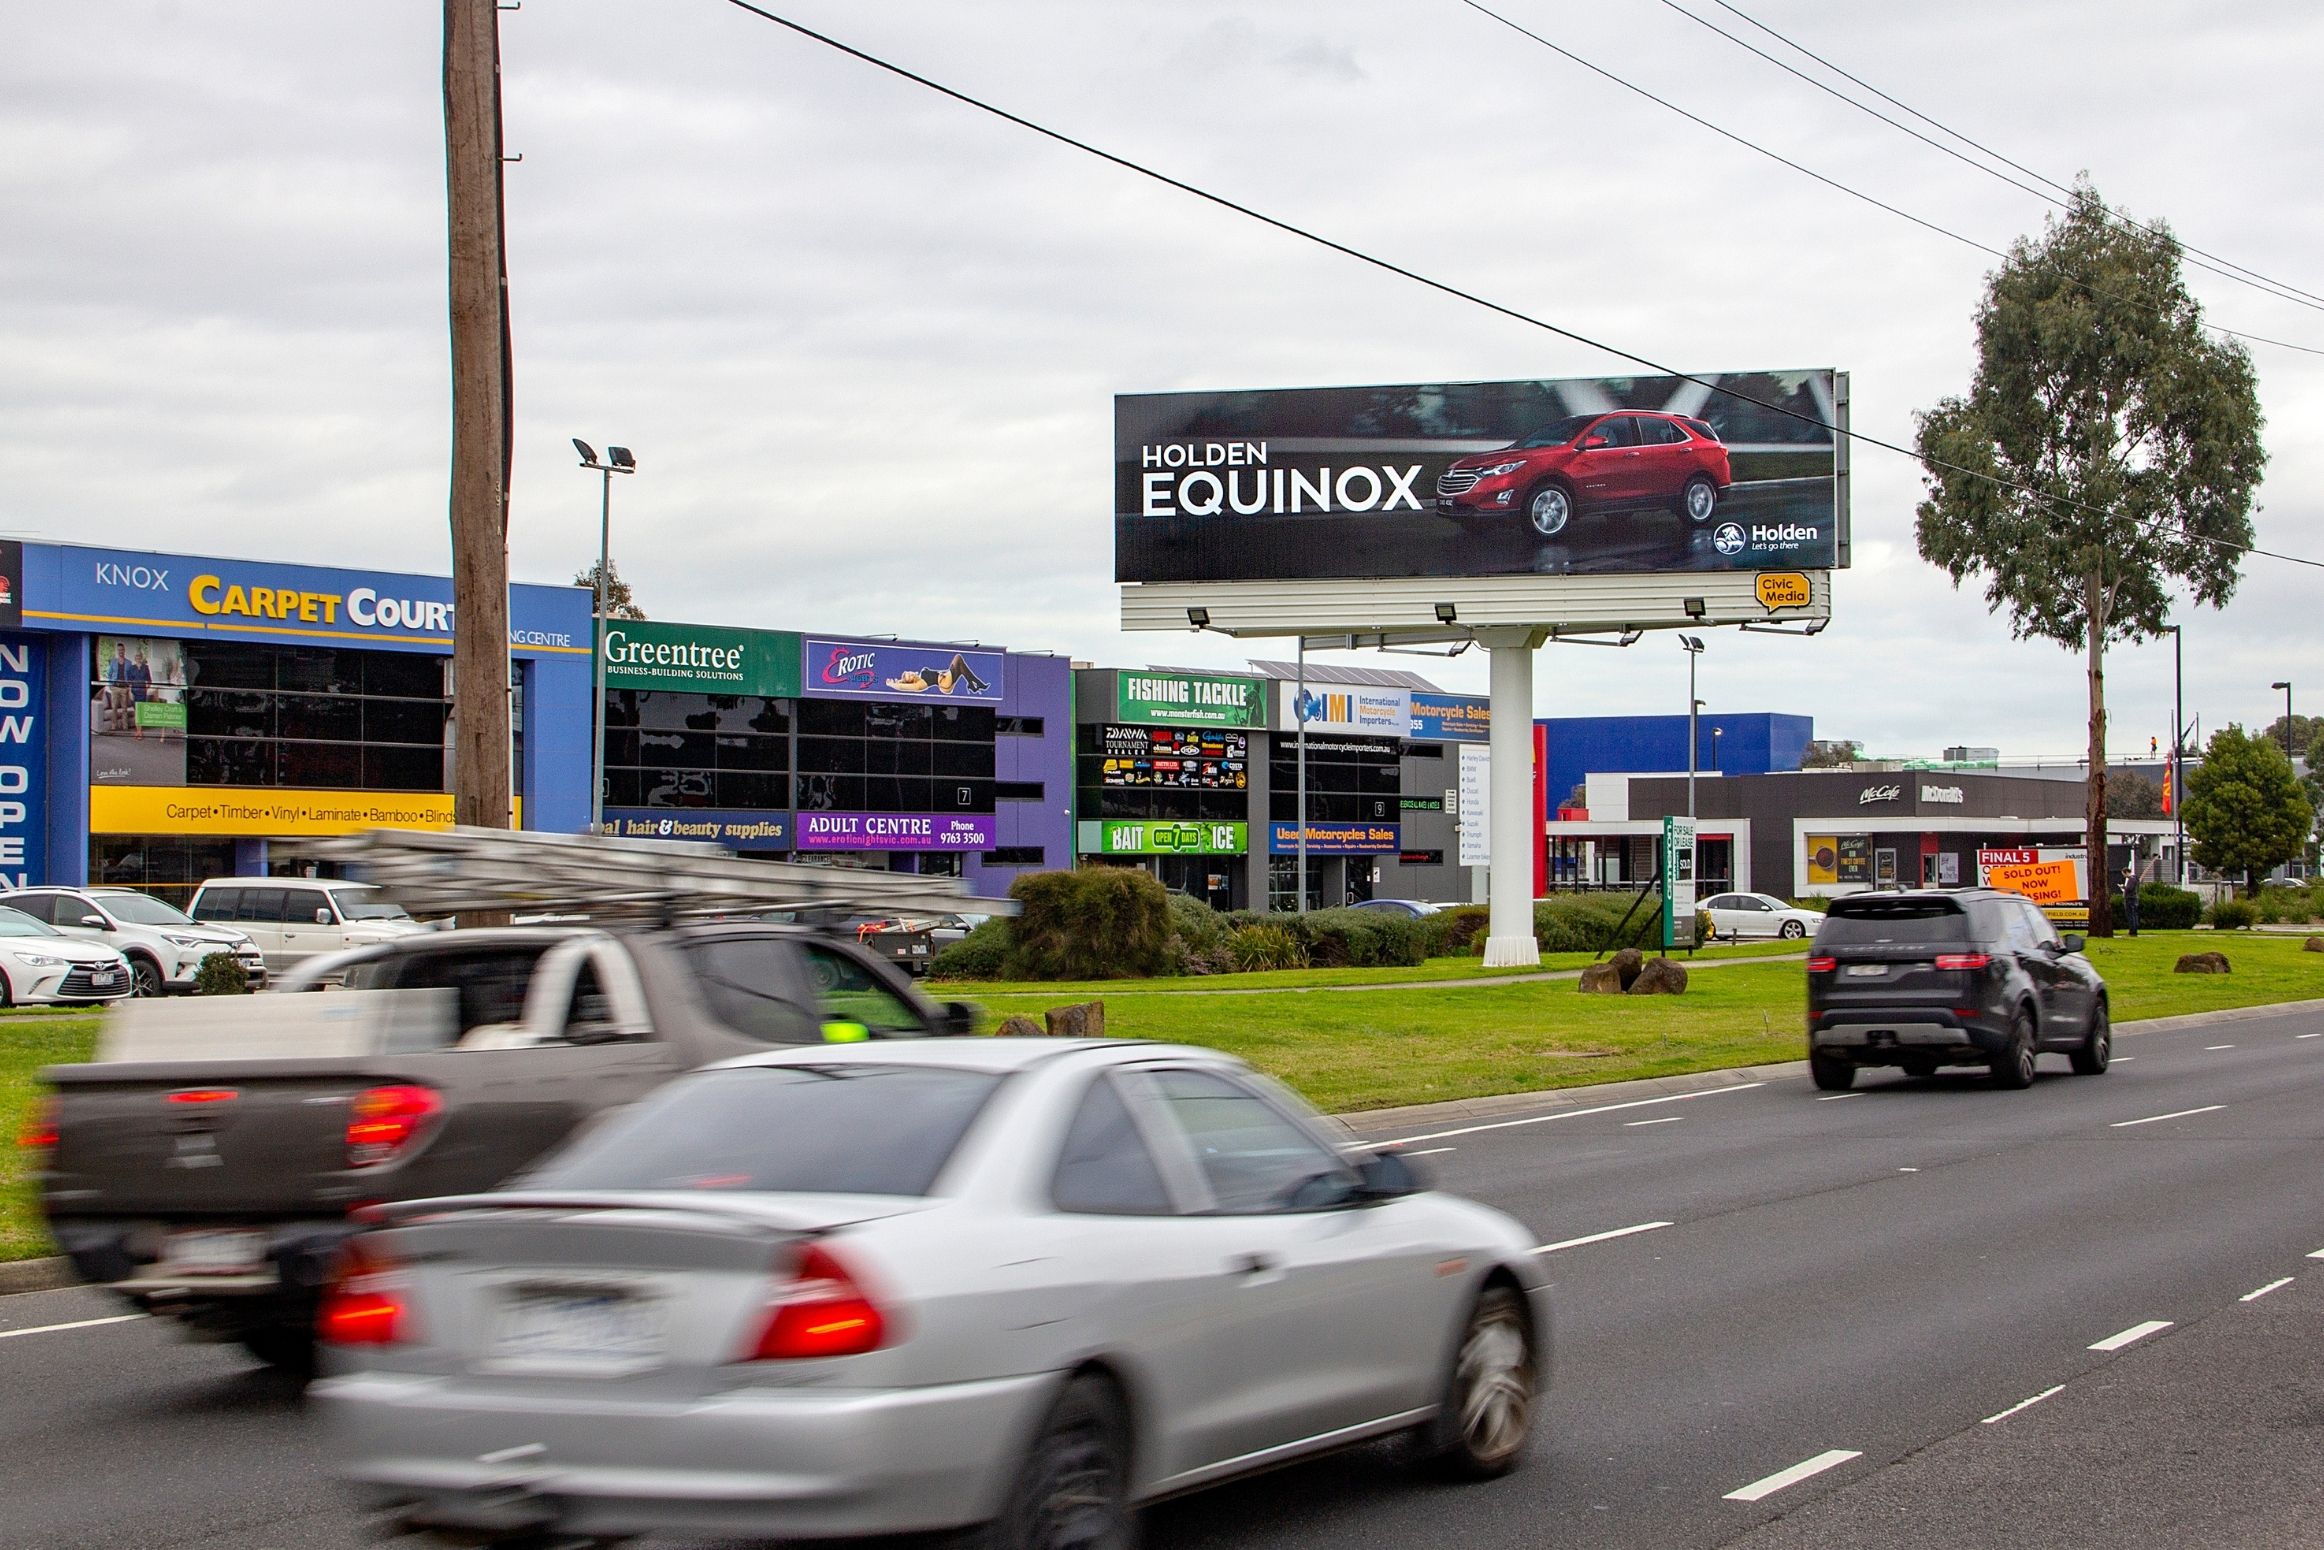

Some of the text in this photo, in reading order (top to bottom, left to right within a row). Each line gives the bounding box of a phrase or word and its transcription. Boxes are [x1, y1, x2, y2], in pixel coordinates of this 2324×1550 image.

[1142, 441, 1267, 468] HOLDEN
[1142, 464, 1424, 517] EQUINOX
[1752, 523, 1818, 541] Holden
[1751, 541, 1799, 552] Let's go there
[96, 562, 170, 592] KNOX
[1762, 579, 1793, 590] Civic
[1765, 591, 1805, 601] Media
[527, 631, 571, 648] CENTRE
[607, 665, 744, 681] BUSINESS-BUILDING SOLUTIONS
[1128, 677, 1247, 706] FISHING TACKLE
[1360, 695, 1401, 707] International
[1150, 708, 1226, 720] www.monsterfish.com.au
[1360, 705, 1396, 717] Motorcycle
[1410, 701, 1491, 721] Motorcycle Sales
[1360, 715, 1391, 727] Importers
[1105, 740, 1149, 750] TOURNAMENT
[961, 790, 968, 802] 7
[166, 803, 212, 821] Carpet
[219, 804, 263, 819] Timber
[271, 805, 300, 823] Vinyl
[308, 807, 361, 821] Laminate
[369, 807, 418, 823] Bamboo
[626, 819, 658, 835] hair
[673, 820, 722, 839] beauty
[725, 821, 782, 840] supplies
[808, 817, 932, 835] ADULT CENTRE
[950, 820, 975, 831] Phone
[1674, 824, 1693, 836] FOR SALE
[940, 832, 985, 845] 9763 3500
[1112, 826, 1144, 850] BAIT
[1155, 828, 1197, 847] OPEN 7 DAYS
[1212, 826, 1234, 849] ICE
[1305, 828, 1366, 843] Motorcycles
[1368, 828, 1394, 840] Sales
[1681, 837, 1693, 848] LEASE
[1981, 851, 2031, 863] FINAL 5
[2003, 868, 2033, 880] SOLD
[2035, 865, 2061, 876] OUT!
[2022, 879, 2049, 890] NOW
